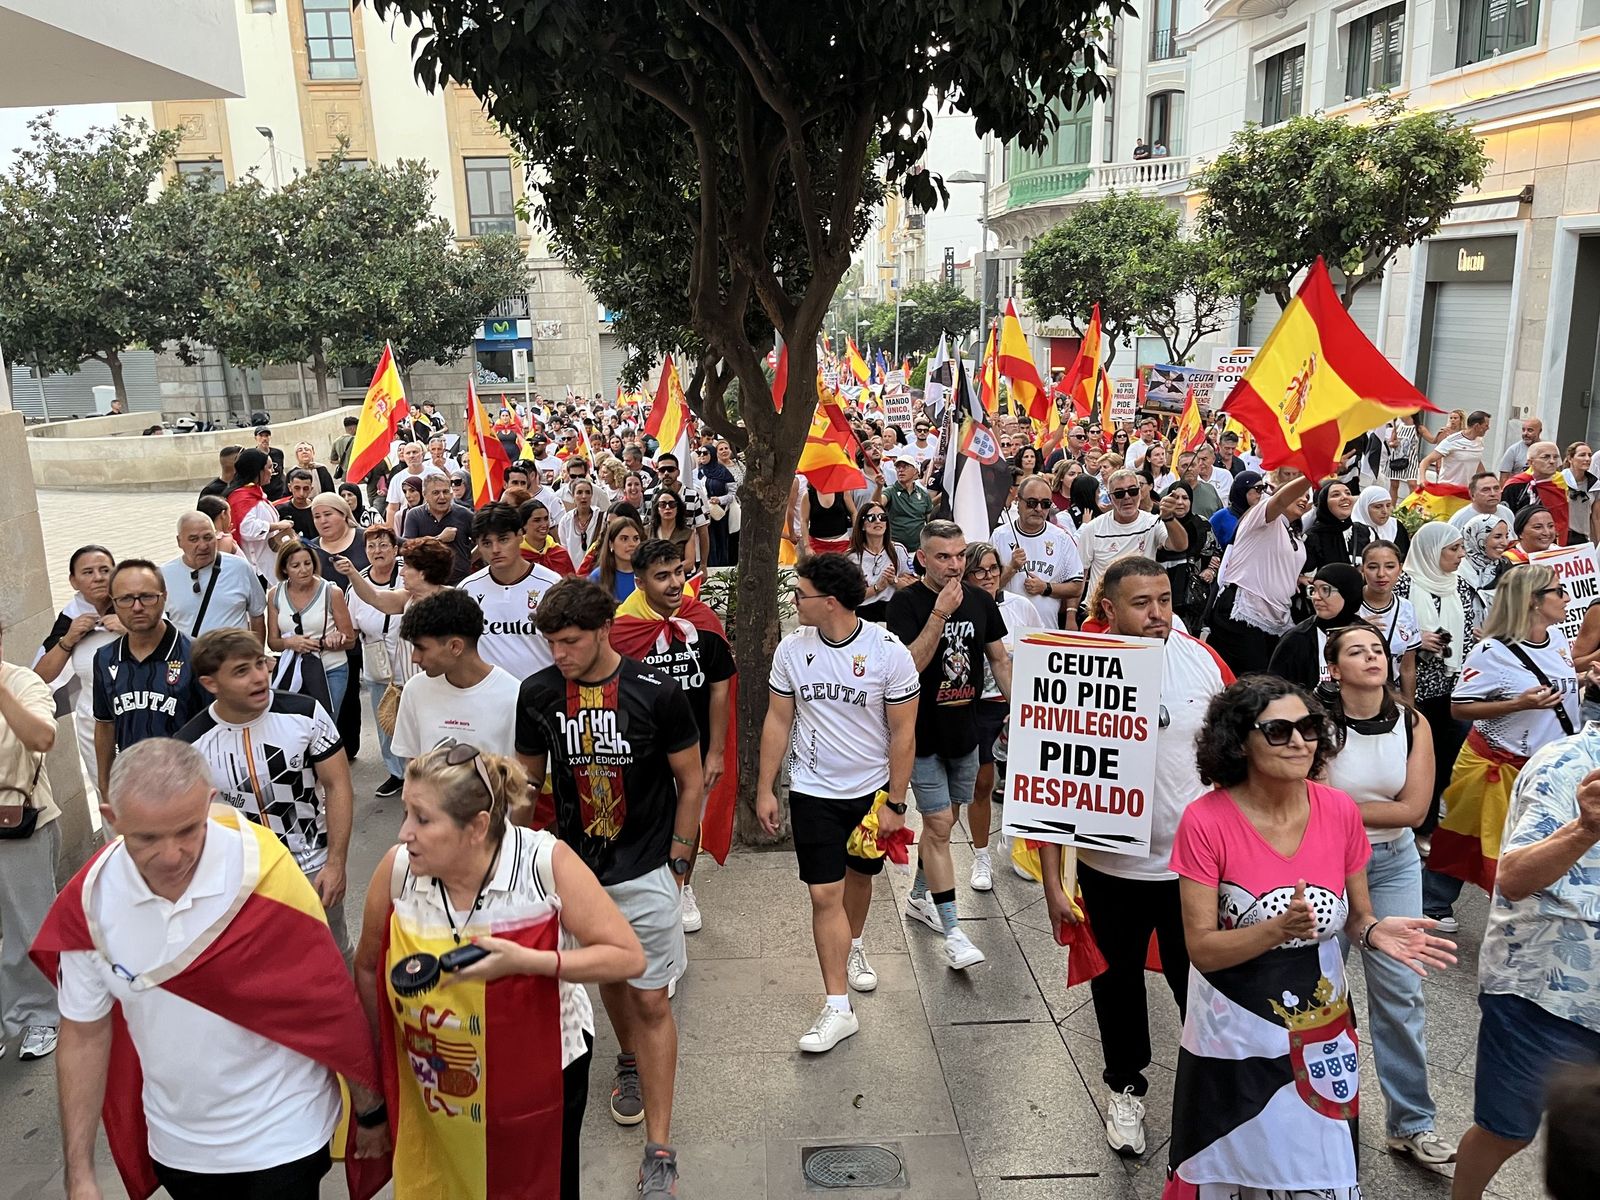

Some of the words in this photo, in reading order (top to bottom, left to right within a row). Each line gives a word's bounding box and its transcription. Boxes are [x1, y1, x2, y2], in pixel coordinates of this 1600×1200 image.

[1219, 356, 1255, 364] CEUT
[1188, 374, 1213, 382] CEUTA
[1017, 561, 1055, 576] UTA
[1555, 556, 1595, 579] PAÑA
[1572, 578, 1599, 599] UNE
[943, 621, 975, 639] EUTA
[673, 664, 688, 673] SU
[1048, 652, 1124, 679] CEUTA
[800, 683, 868, 707] CEUTA
[936, 685, 976, 701] ESPAÑA
[940, 681, 951, 689] ES
[1034, 677, 1067, 704] NO
[1078, 681, 1137, 712] PIDE
[113, 691, 178, 717] CEUTA
[1020, 704, 1148, 742] PRIVILEGIOS
[569, 756, 591, 765] XXIV
[595, 756, 633, 765] EDICIÓN
[1040, 740, 1119, 780] PIDE
[1013, 774, 1145, 818] RESPALDO
